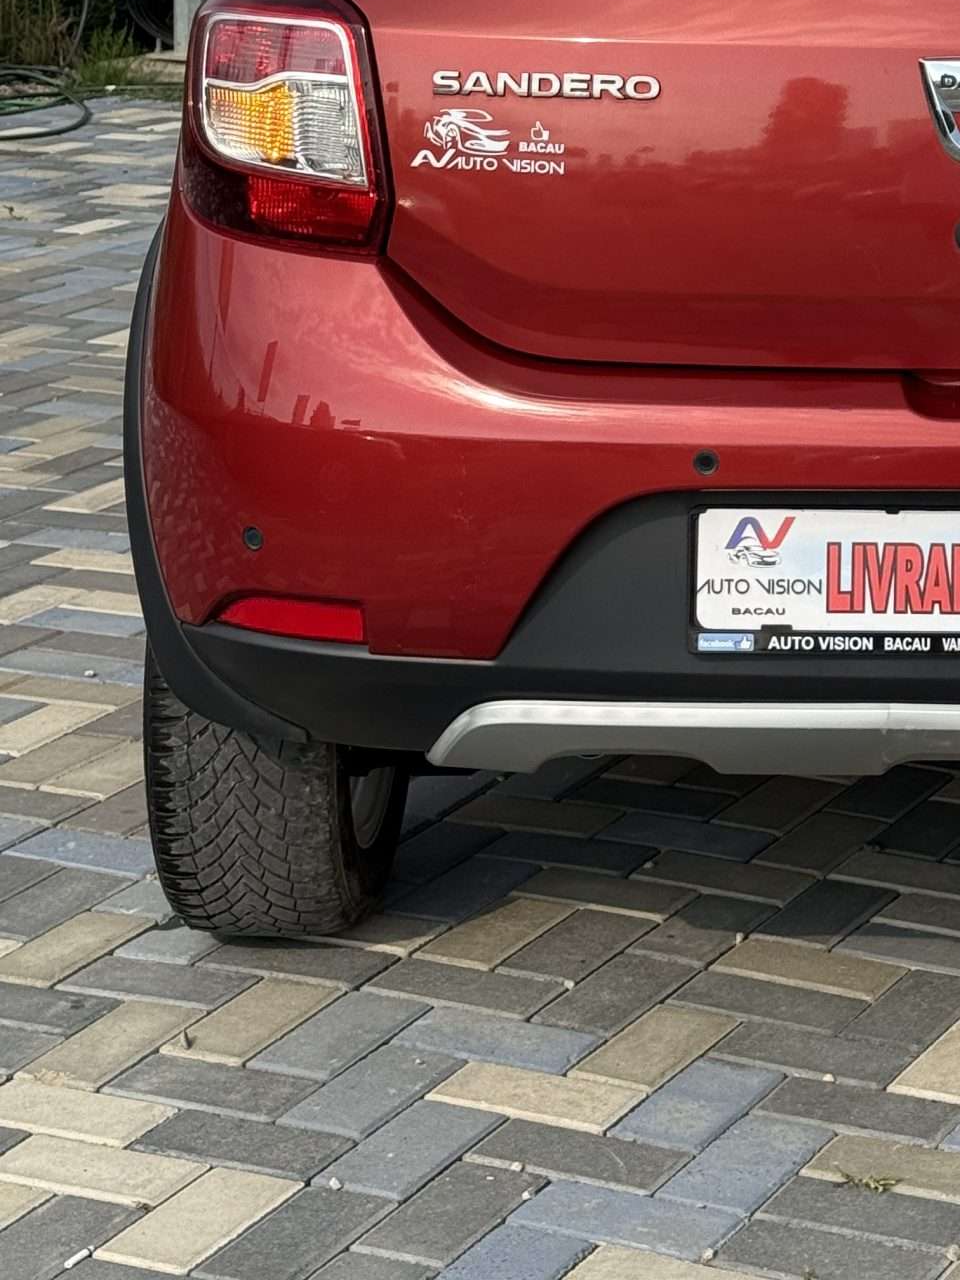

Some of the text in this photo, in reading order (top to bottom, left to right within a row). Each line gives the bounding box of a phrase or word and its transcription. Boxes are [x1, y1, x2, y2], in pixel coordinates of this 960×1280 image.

[432, 70, 661, 100] SANDERO
[519, 141, 565, 154] BACAU
[449, 157, 498, 171] AUTO
[502, 158, 565, 175] VISION
[697, 578, 823, 596] AUTO VISION
[731, 607, 786, 616] BACAU
[767, 636, 814, 651] AUTO
[818, 636, 874, 651] VISION
[884, 637, 931, 652] BACAU
